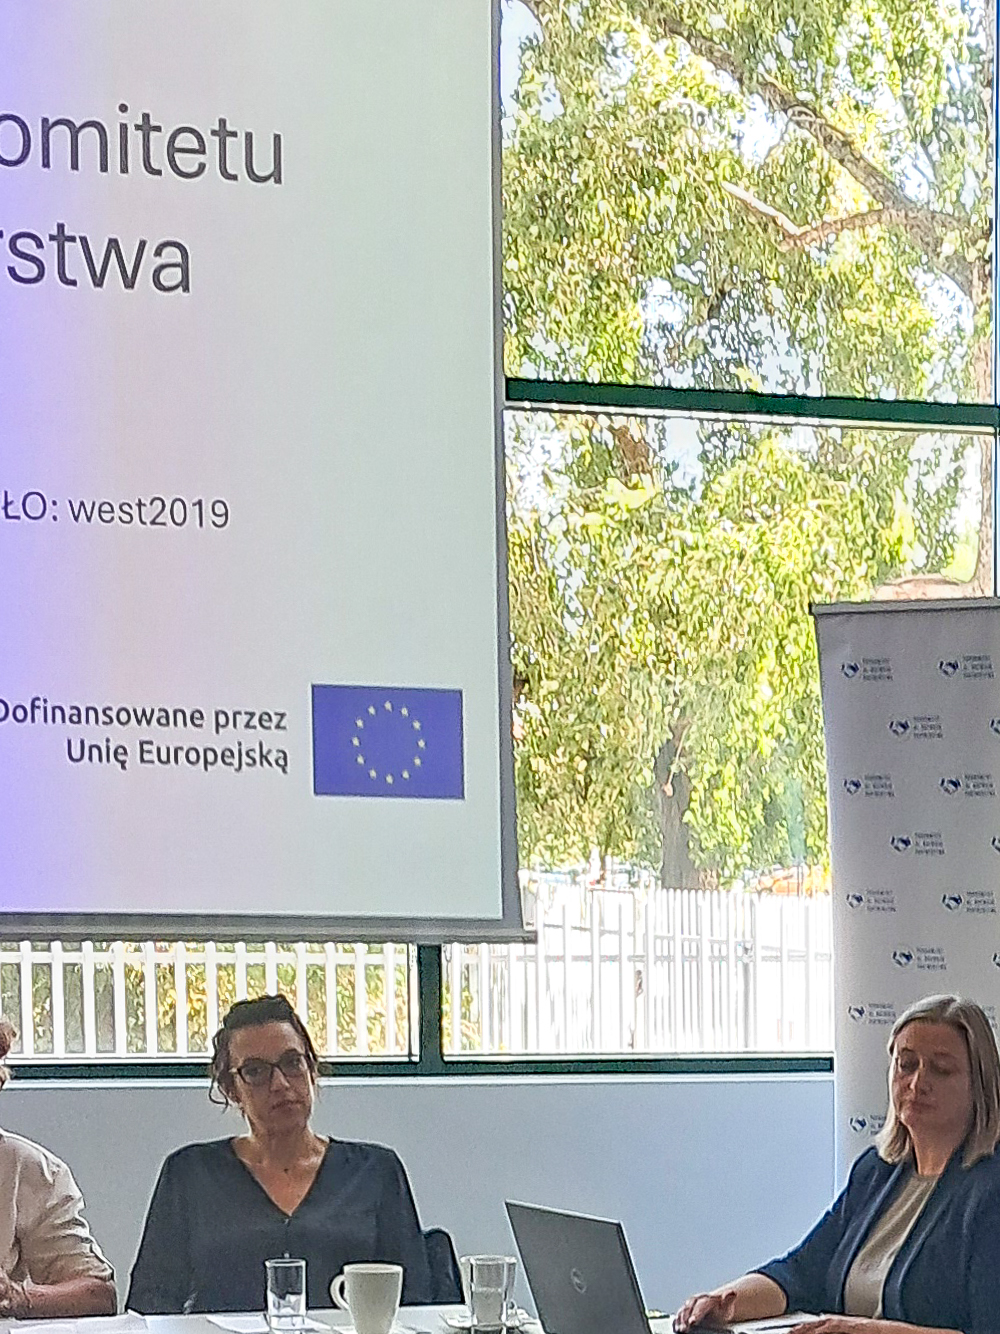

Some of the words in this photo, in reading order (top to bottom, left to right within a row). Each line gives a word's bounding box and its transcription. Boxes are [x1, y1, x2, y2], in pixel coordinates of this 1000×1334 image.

[0, 222, 191, 294] stwa
[67, 495, 230, 530] west2019
[214, 708, 288, 735] przez
[66, 736, 129, 771] Unię
[138, 739, 289, 775] Europejską
